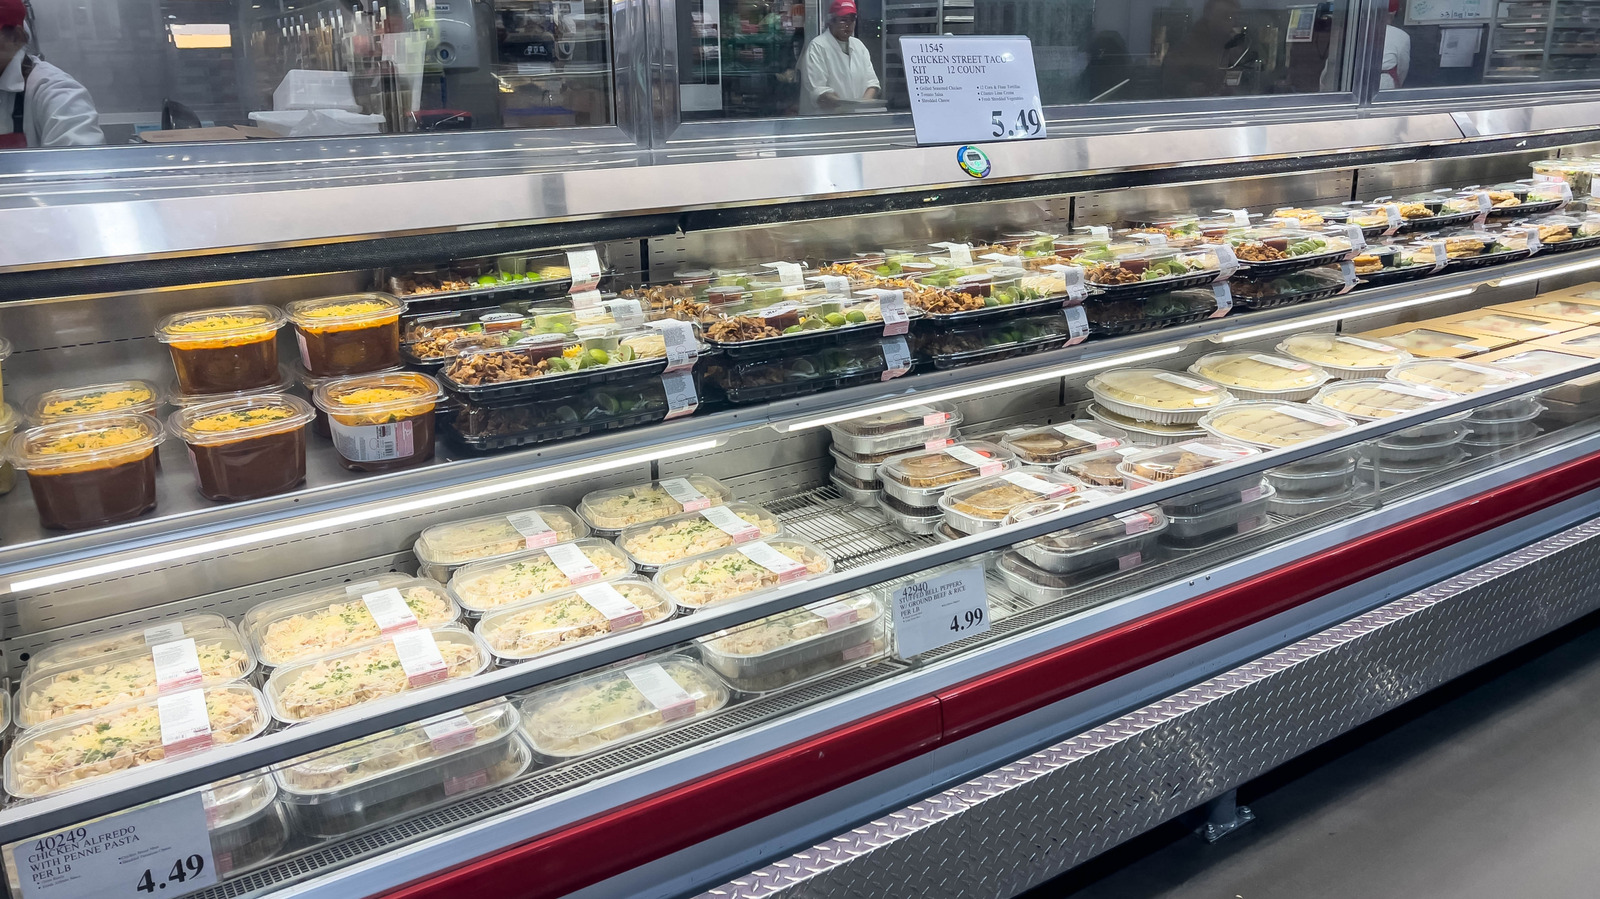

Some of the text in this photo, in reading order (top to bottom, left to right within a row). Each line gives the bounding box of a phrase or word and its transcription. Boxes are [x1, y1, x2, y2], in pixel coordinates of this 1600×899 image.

[910, 55, 950, 64] CHICKEN
[951, 55, 982, 64] STREET
[919, 43, 944, 53] 11545
[912, 65, 986, 74] KIT 12 COUNT
[913, 75, 944, 84] PER LB
[991, 109, 1042, 138] 5.49
[898, 580, 963, 605] STUFFED BELL PEPPERS
[902, 581, 929, 598] 42940
[908, 595, 933, 608] GROUND
[933, 591, 947, 600] BEEF
[953, 585, 966, 594] RICE
[900, 609, 912, 618] PER
[912, 606, 921, 614] LB
[950, 607, 984, 633] 4.99
[28, 825, 136, 864] CHICKEN ALFREDO
[34, 827, 87, 853] 40249
[30, 858, 61, 873] WITH
[64, 846, 102, 863] PENNE
[104, 834, 140, 851] PASTA
[32, 870, 54, 883] PER
[57, 864, 72, 876] LB
[136, 853, 205, 894] 4.49
